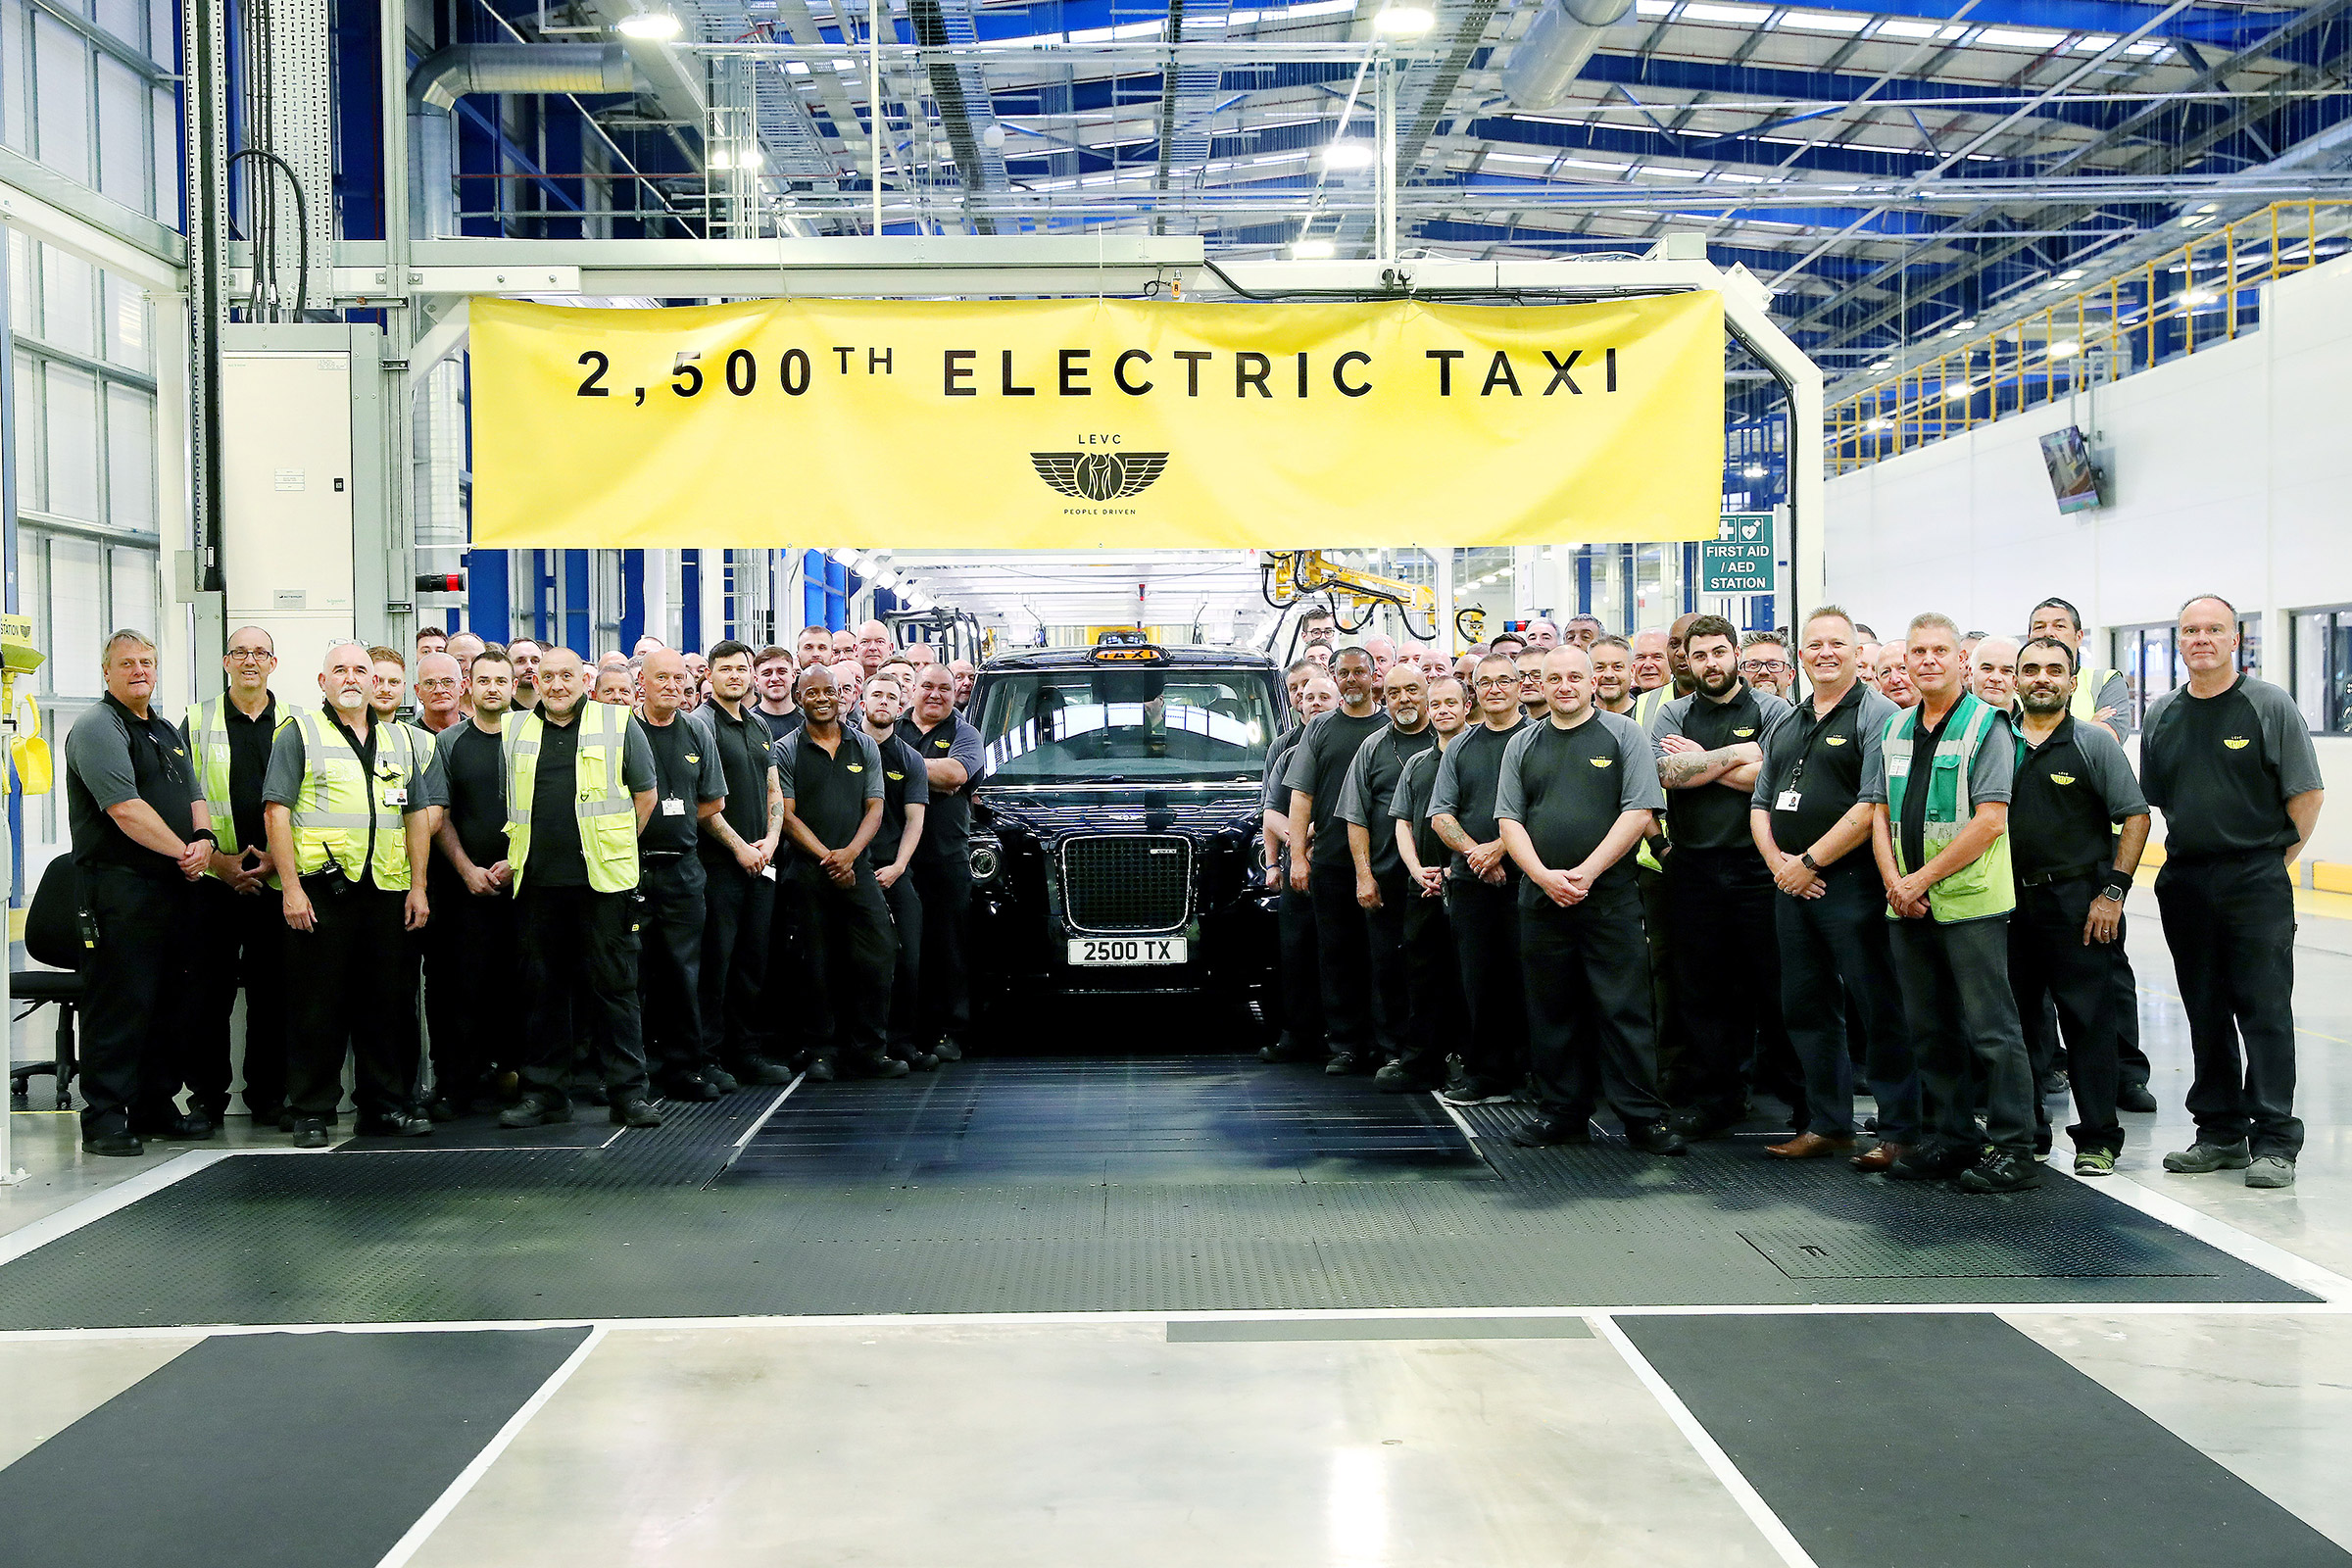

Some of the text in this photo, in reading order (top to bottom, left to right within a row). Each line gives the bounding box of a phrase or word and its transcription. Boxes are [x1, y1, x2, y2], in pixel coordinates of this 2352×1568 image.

[944, 349, 1373, 398] ELECTRIC
[1425, 347, 1617, 397] TAXI
[1078, 434, 1121, 445] LEVC
[1706, 545, 1770, 558] FIRST AID
[1720, 562, 1756, 573] / AED
[1710, 576, 1766, 589] STATION
[1102, 650, 1154, 660] TAXI
[1084, 941, 1171, 961] 2500 TX
